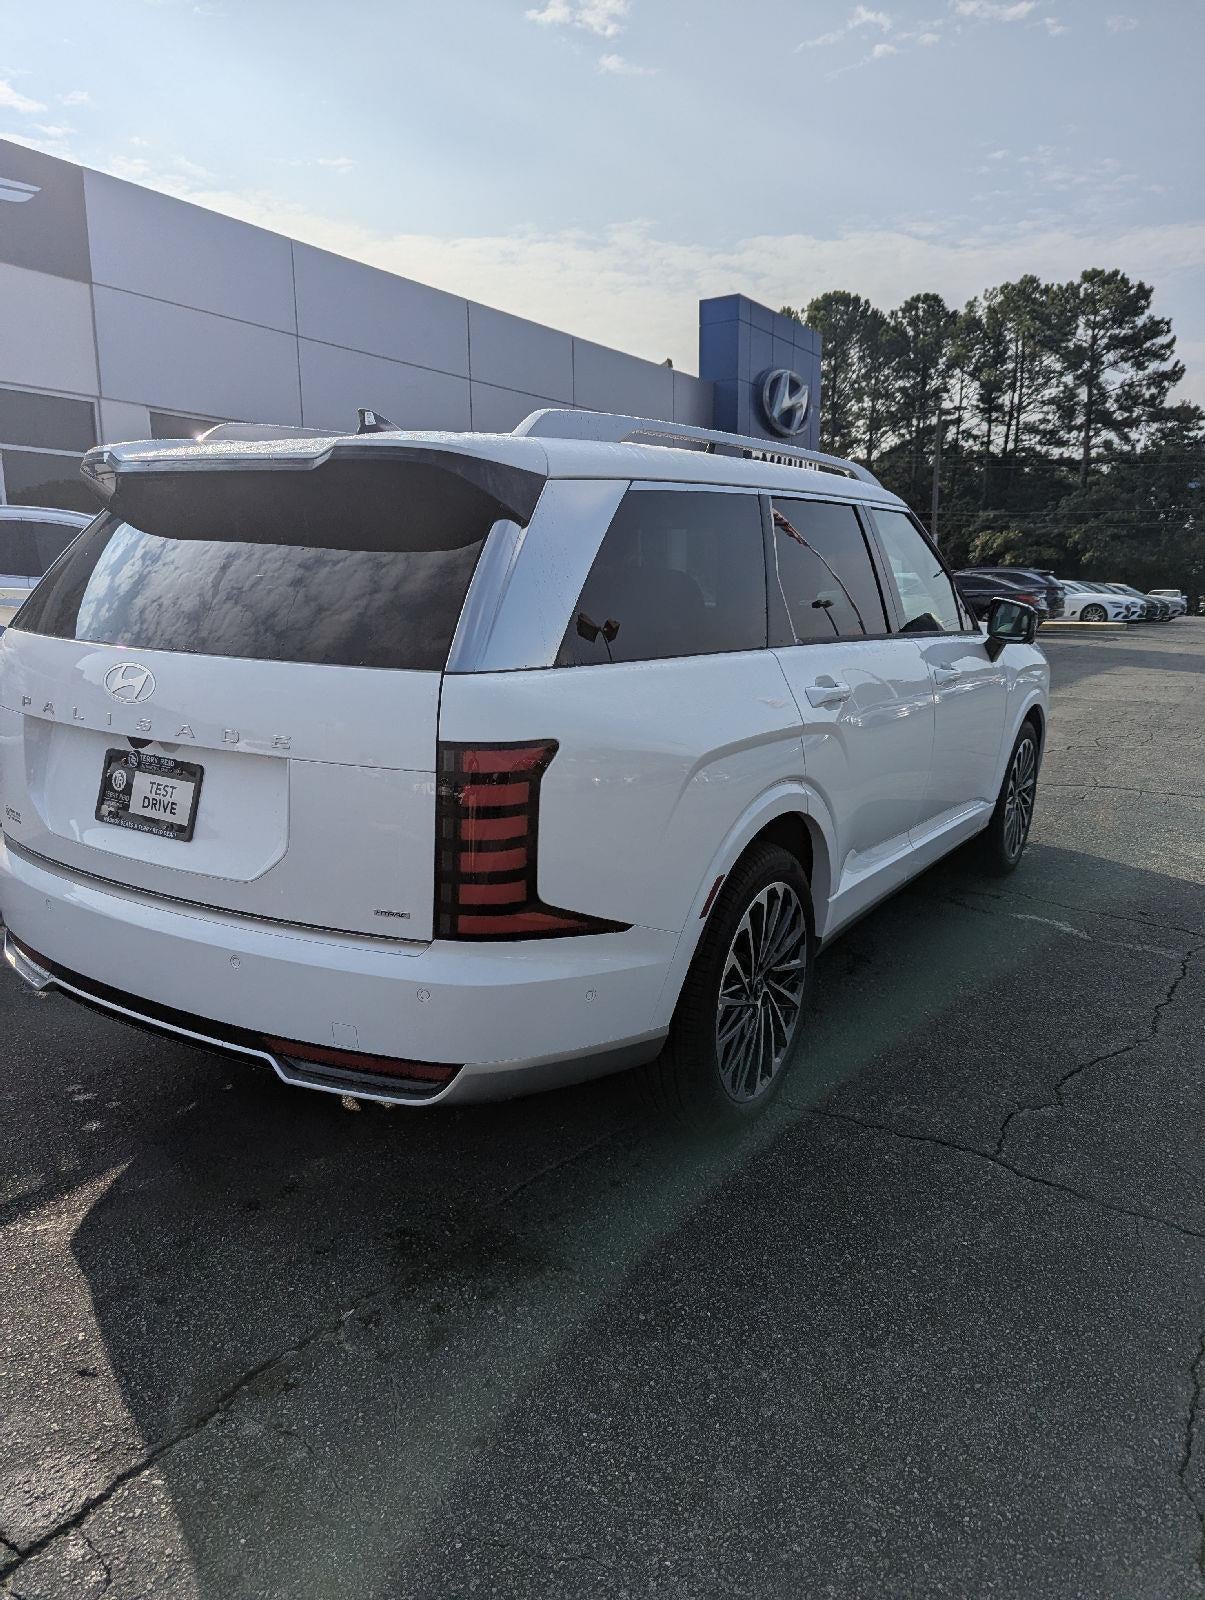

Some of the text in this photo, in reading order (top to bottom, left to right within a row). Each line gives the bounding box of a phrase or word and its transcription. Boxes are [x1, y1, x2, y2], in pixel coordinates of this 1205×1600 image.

[22, 694, 291, 749] PALISADE
[150, 781, 177, 799] TEST
[142, 796, 178, 815] DRIVE
